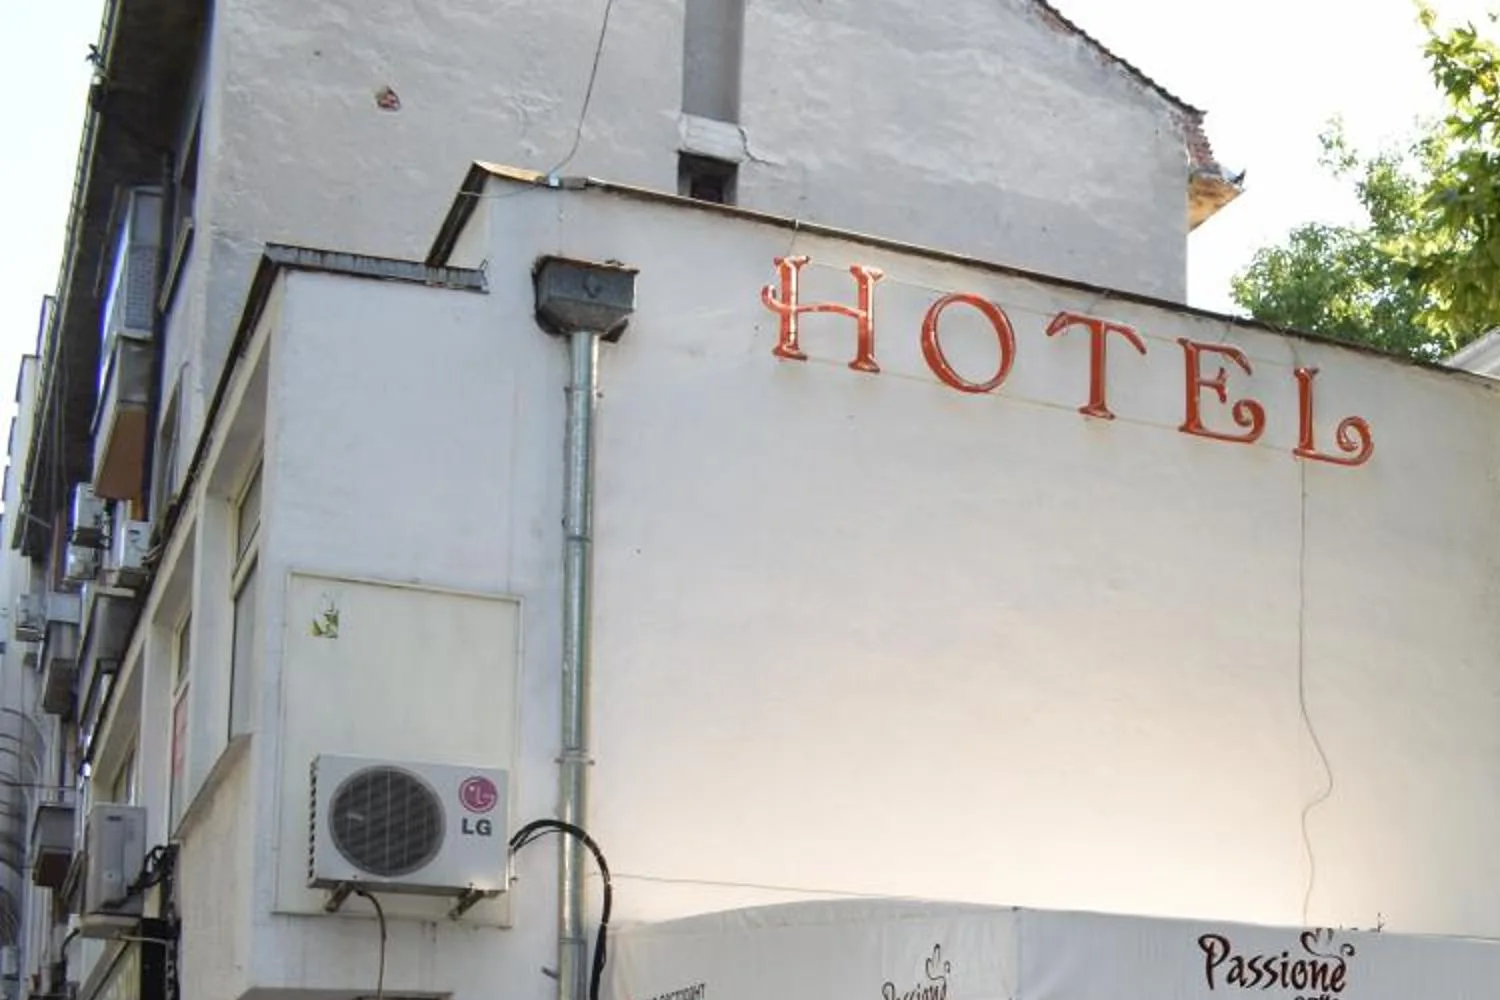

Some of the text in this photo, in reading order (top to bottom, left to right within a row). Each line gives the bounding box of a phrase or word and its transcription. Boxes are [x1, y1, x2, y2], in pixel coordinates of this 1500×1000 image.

[760, 254, 1376, 467] HOTEL
[461, 818, 493, 836] LG
[1198, 933, 1349, 992] Passione
